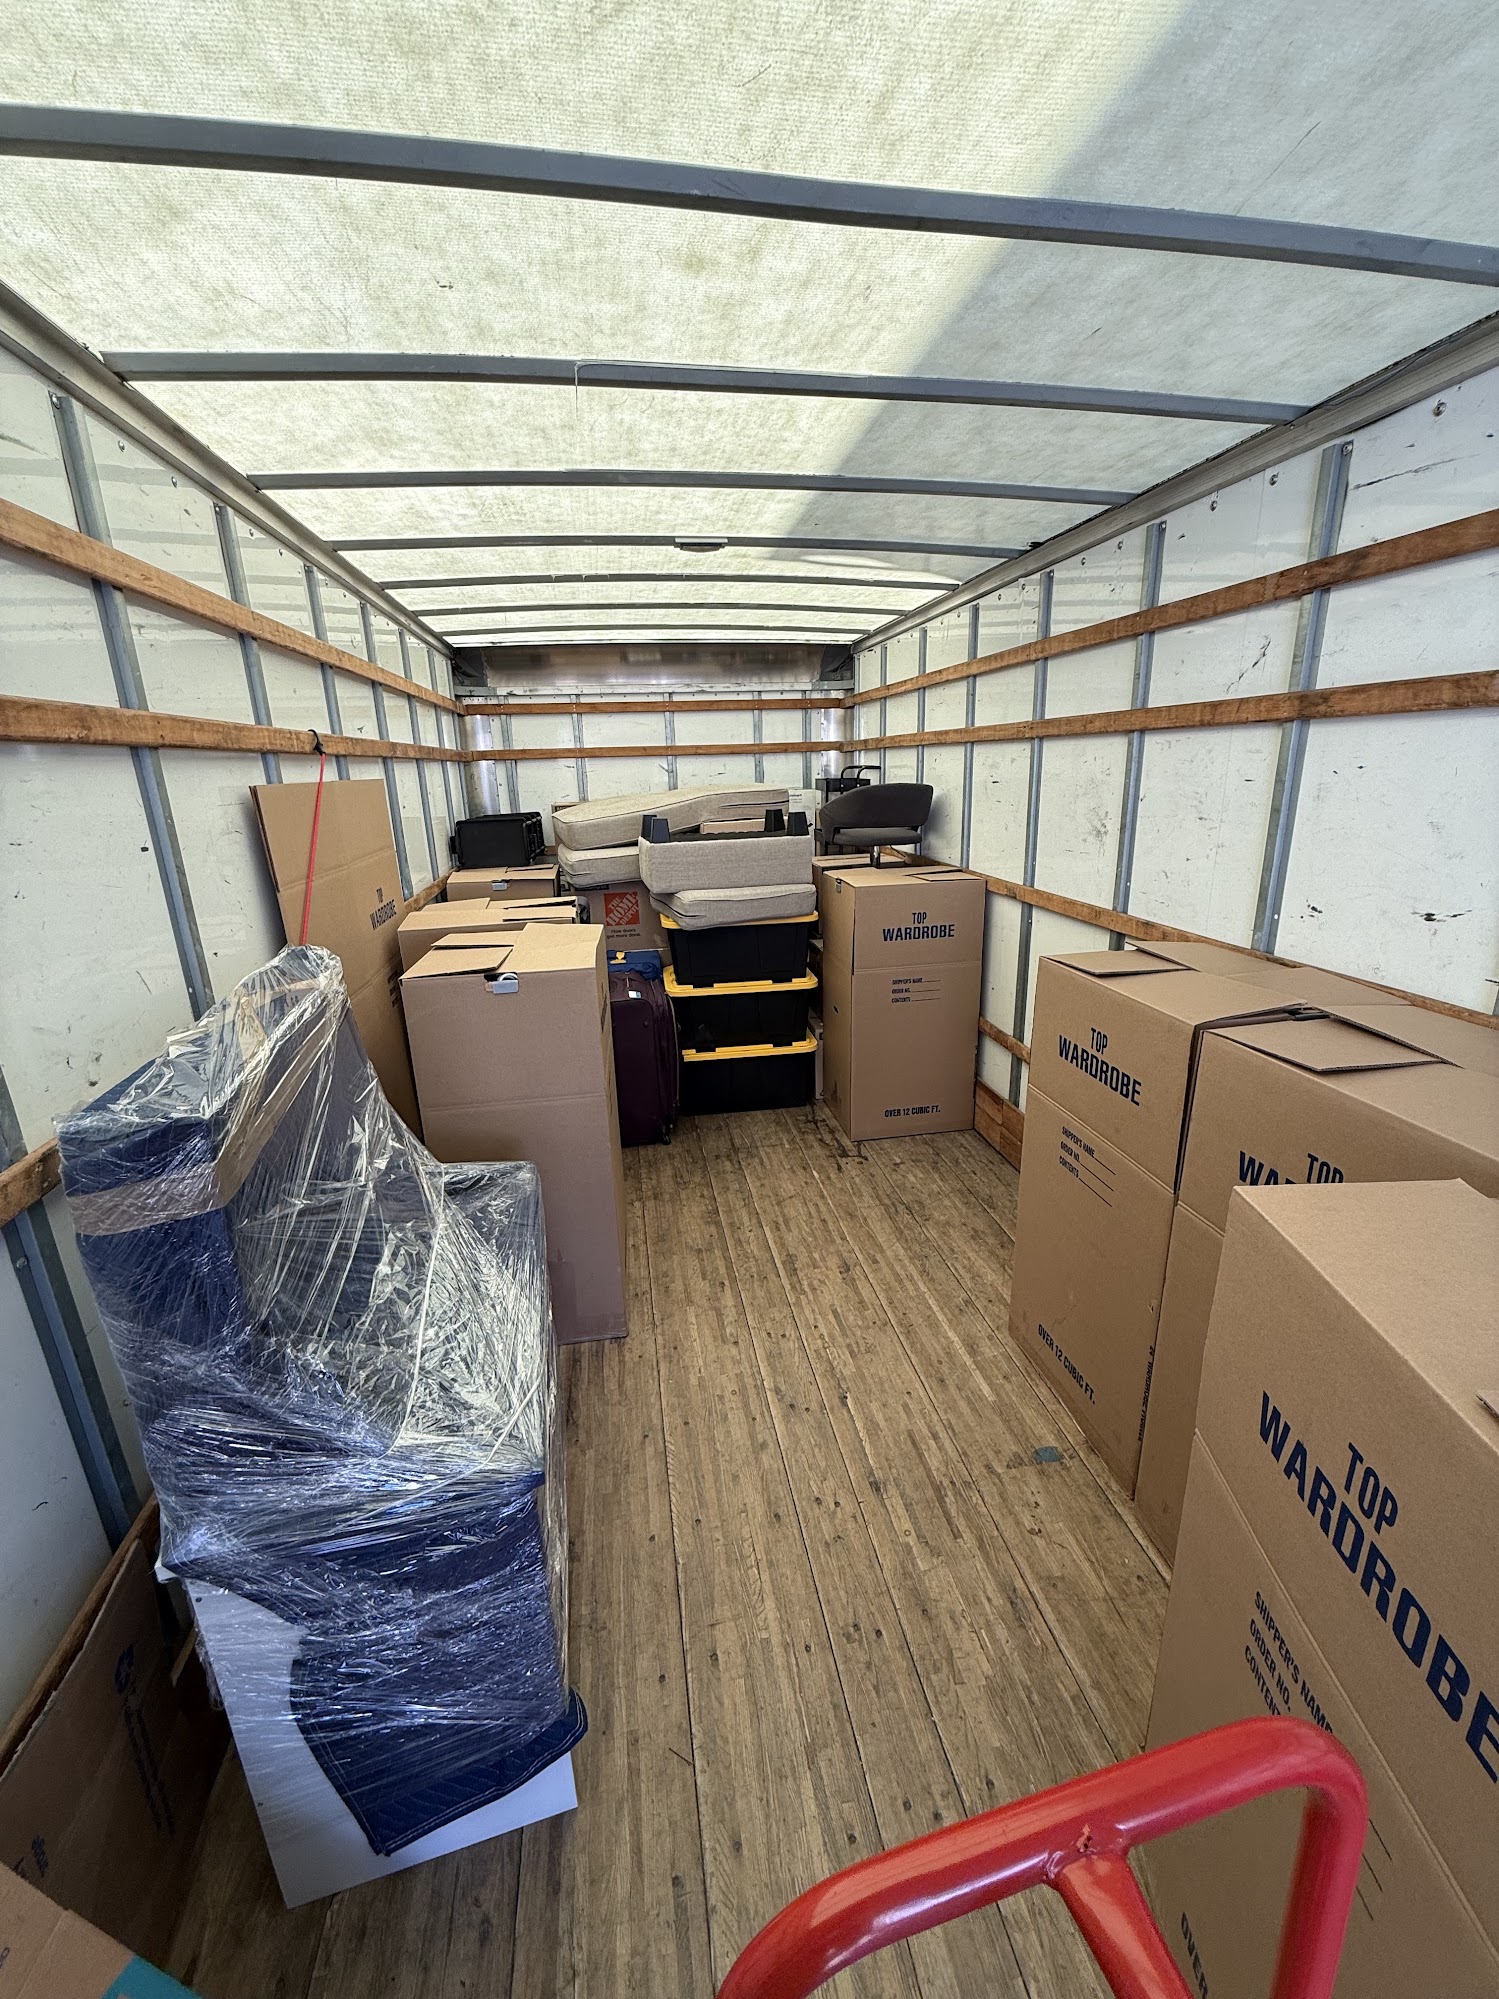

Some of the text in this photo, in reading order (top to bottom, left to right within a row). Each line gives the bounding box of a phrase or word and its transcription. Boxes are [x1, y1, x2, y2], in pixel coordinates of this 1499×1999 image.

[369, 899, 397, 930] WARDROBE
[606, 892, 638, 926] HOME
[608, 897, 622, 910] THE
[912, 912, 927, 924] TOP
[882, 924, 955, 941] WARDROBE
[1090, 1027, 1108, 1055] TOP
[1059, 1034, 1142, 1107] WARDROBE
[884, 1104, 941, 1117] OVER 12 CUBIC FT.
[1060, 1140, 1074, 1157] ORDER
[1082, 1141, 1095, 1158] NAME
[1059, 1155, 1080, 1178] CONTENTS
[1038, 1323, 1096, 1405] OVER 12 CUBIC FT.
[1343, 1441, 1399, 1535] TOP
[1259, 1390, 1499, 1783] WARDROBE
[1254, 1590, 1300, 1684] SHIPPER'S
[1249, 1618, 1291, 1713] ORDER NO.
[1180, 1911, 1208, 1999] OVER
